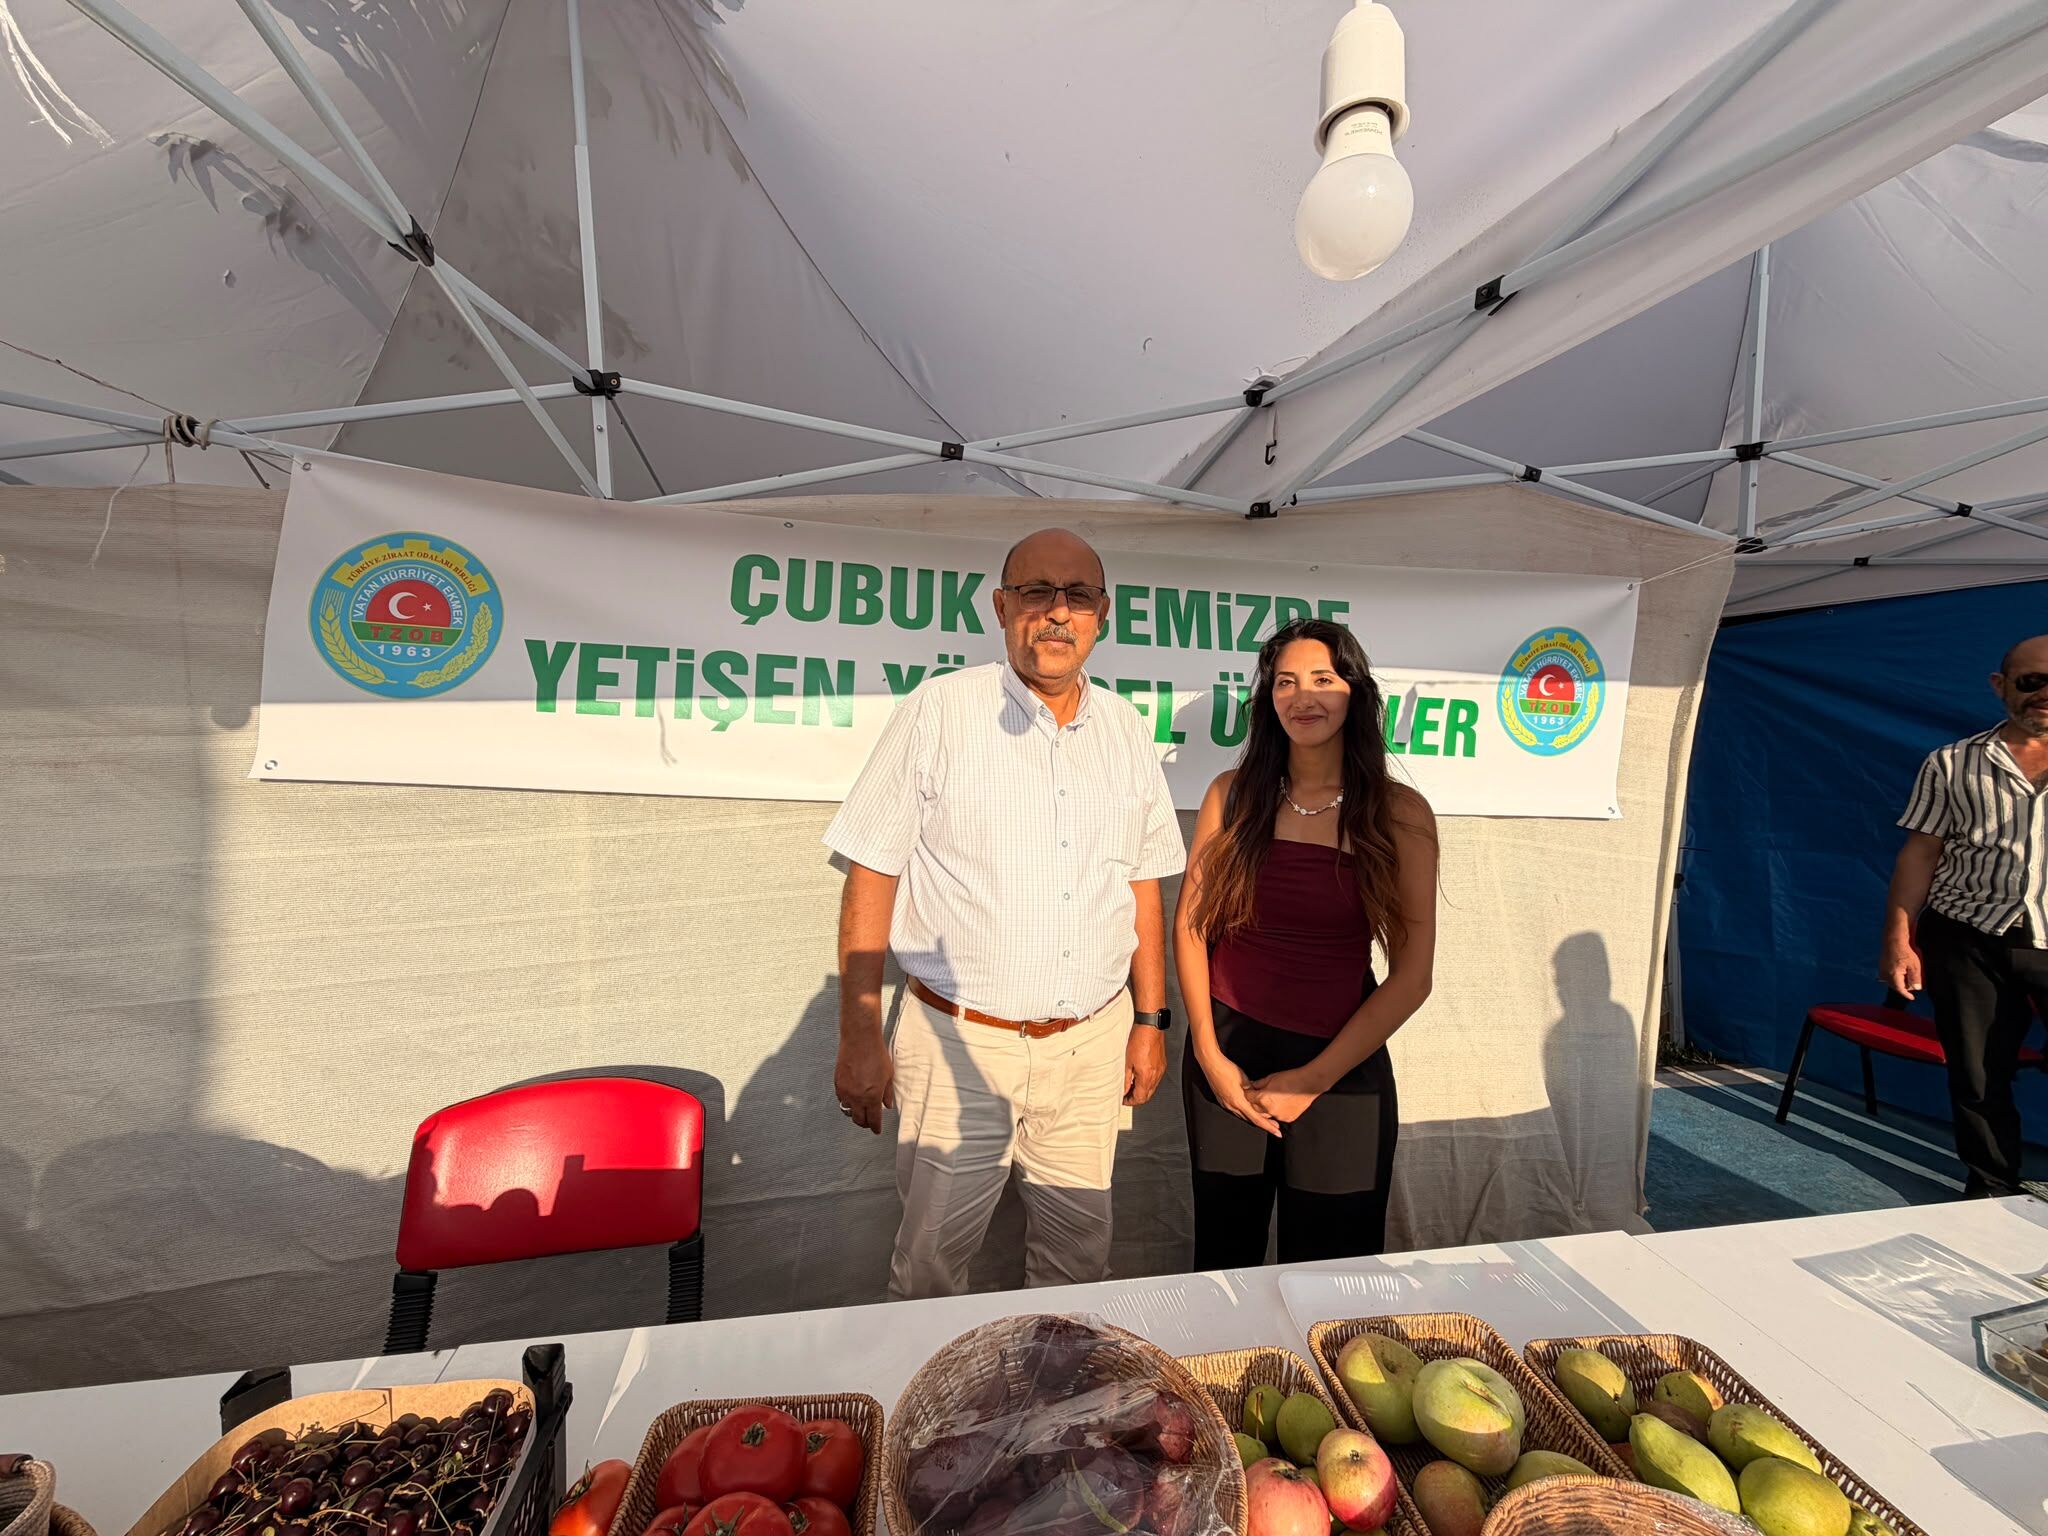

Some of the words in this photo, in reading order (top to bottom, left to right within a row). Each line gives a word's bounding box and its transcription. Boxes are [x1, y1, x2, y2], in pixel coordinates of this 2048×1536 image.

[347, 556, 381, 582] TÜRKİYE
[382, 551, 415, 562] ZİRAAT
[416, 551, 453, 570] ODALARI
[453, 565, 478, 593] BİRLİĞİ
[353, 581, 380, 618] VATAN
[380, 567, 445, 587] HÜRRİYET
[442, 585, 463, 625] EKMEK
[730, 553, 986, 634] ÇUBUK
[370, 625, 444, 643] TZOB
[377, 644, 432, 658] 1963
[1533, 715, 1565, 725] 1963
